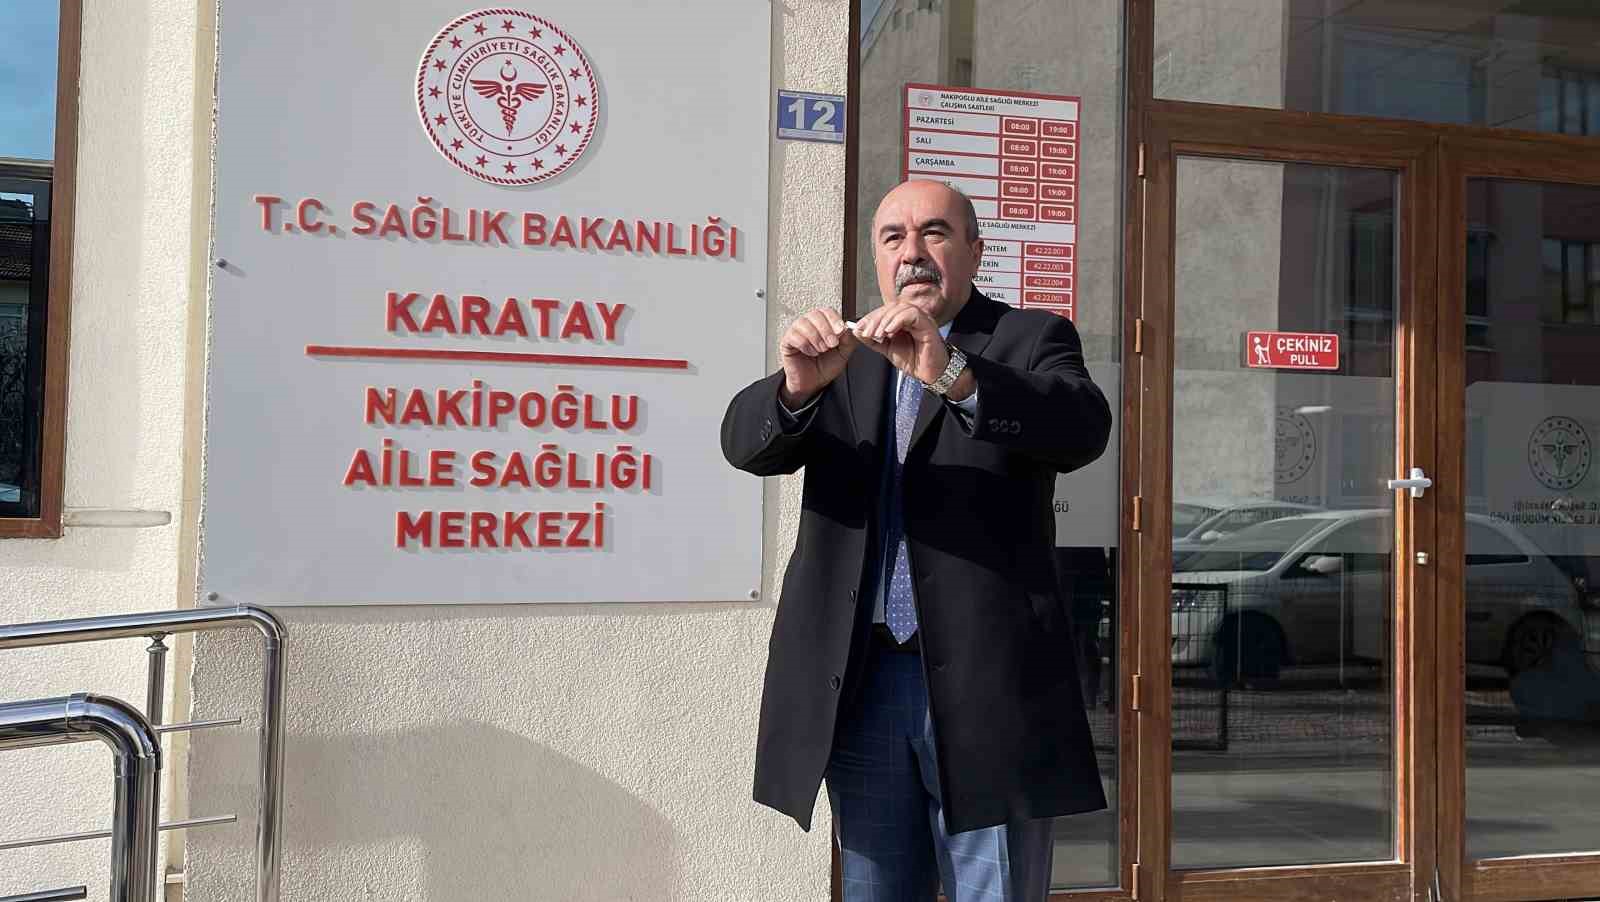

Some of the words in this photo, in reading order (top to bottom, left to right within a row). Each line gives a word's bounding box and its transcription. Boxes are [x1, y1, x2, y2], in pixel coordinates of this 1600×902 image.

[452, 42, 519, 91] CUMHURİYETİ
[524, 46, 560, 80] SAĞLIK
[452, 94, 484, 143] TÜRKİYE
[535, 84, 565, 145] BAKANLIĞI
[788, 99, 836, 131] 12
[915, 157, 956, 167] ÇARŞAMBA
[916, 136, 931, 144] SALI
[256, 196, 338, 232] T.C.
[352, 198, 507, 244] SAĞLIK
[523, 213, 738, 258] BAKANLIĞI
[385, 292, 626, 341] KARATAY
[1276, 336, 1332, 353] ÇEKİNİZ
[1290, 354, 1318, 365] PULL
[364, 380, 638, 430] NAKİPOĞLU
[343, 439, 455, 487] AİLE
[470, 444, 651, 491] SAĞLIĞI
[396, 503, 605, 548] MERKEZİ
